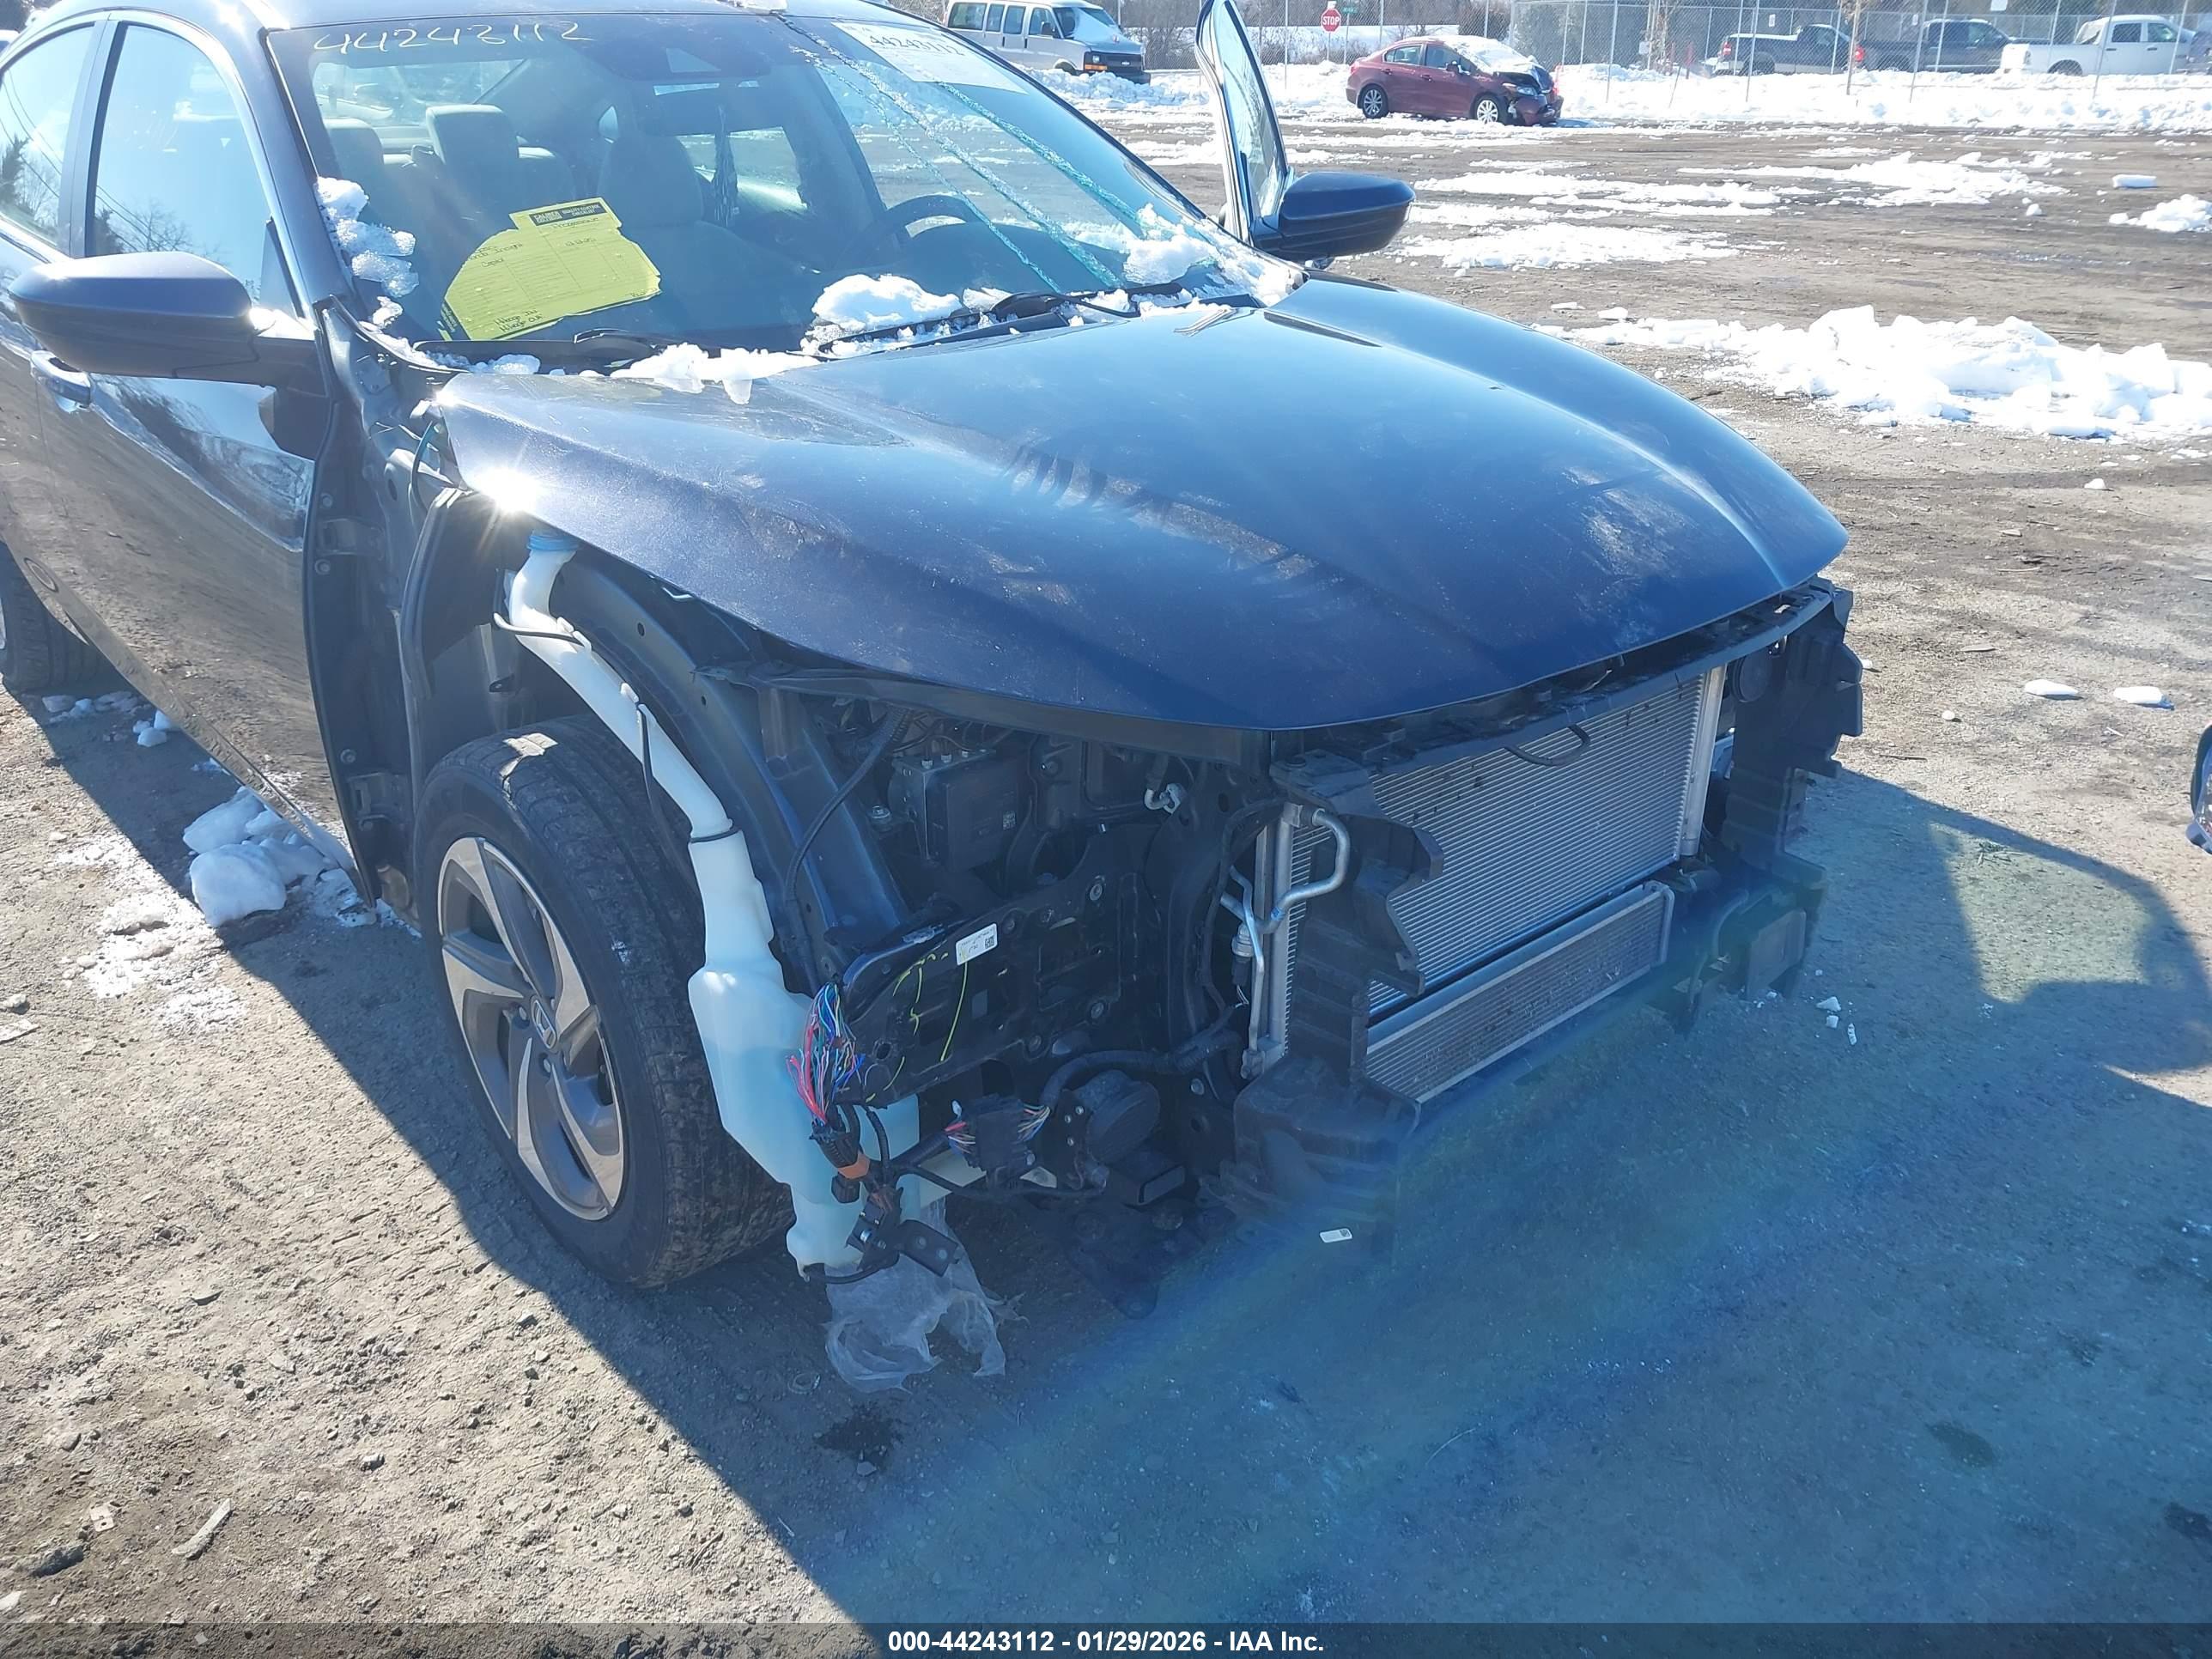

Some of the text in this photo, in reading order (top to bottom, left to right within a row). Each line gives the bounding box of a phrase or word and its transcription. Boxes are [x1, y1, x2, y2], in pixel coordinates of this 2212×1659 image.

[1322, 15, 1340, 26] STOP
[314, 21, 596, 54] 44243112
[869, 35, 965, 56] 44243112
